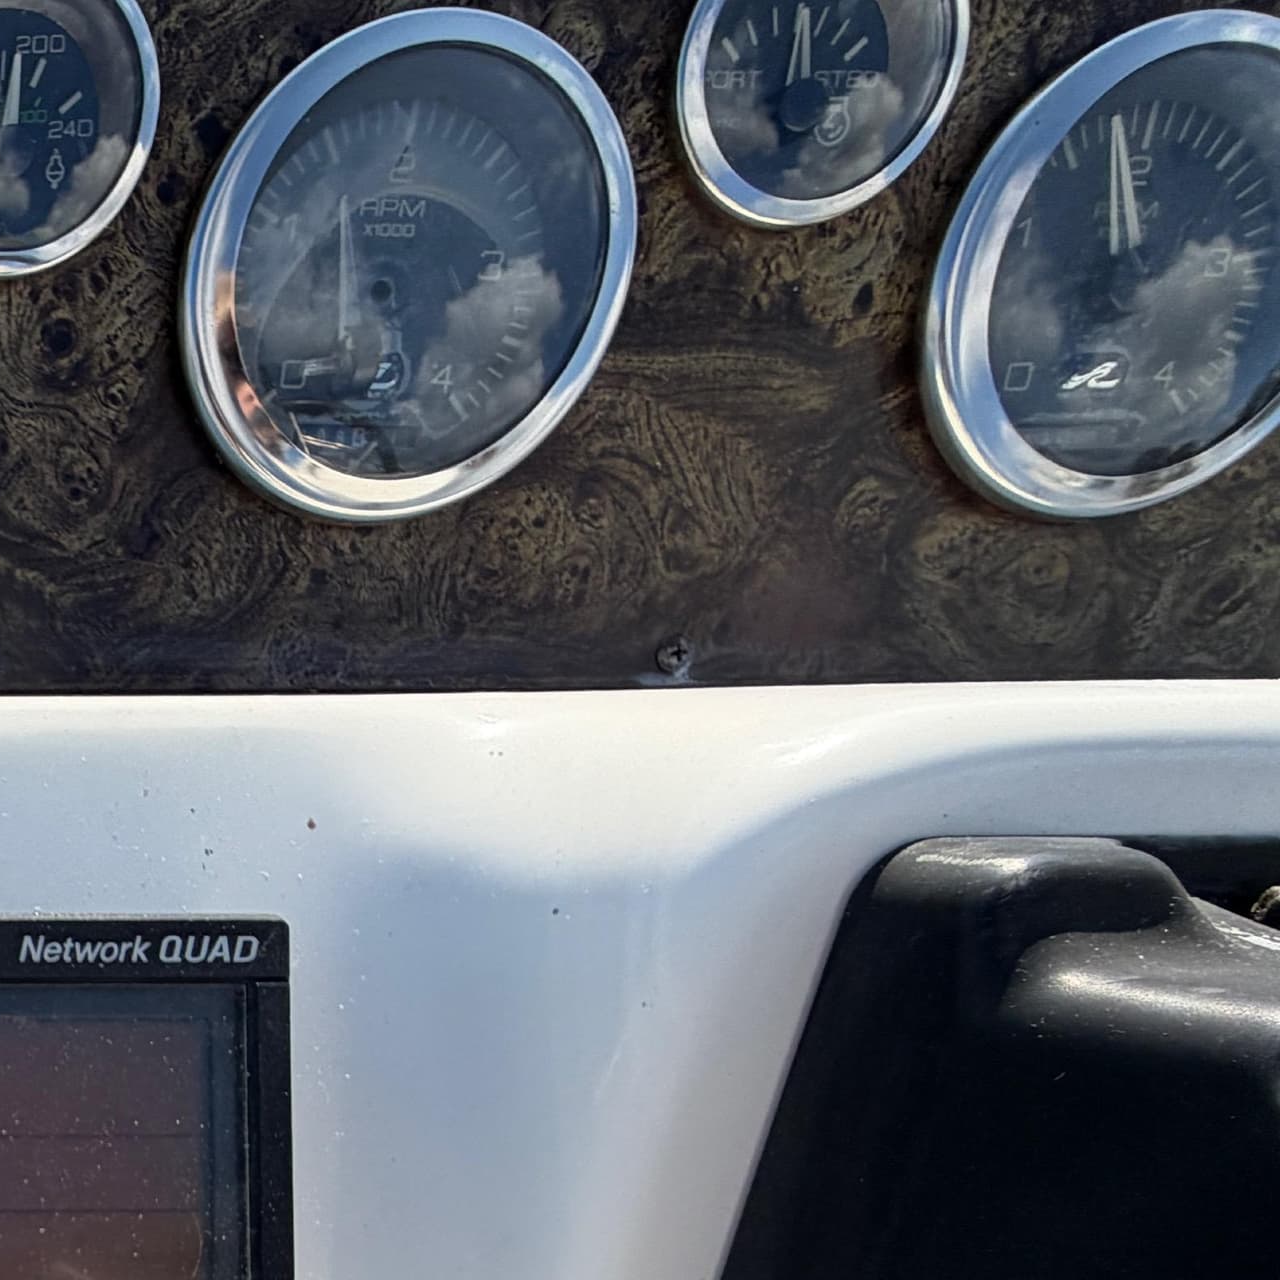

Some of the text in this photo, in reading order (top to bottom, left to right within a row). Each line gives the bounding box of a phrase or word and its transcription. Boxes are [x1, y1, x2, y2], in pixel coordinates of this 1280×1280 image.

[15, 34, 66, 54] 200
[48, 119, 94, 139] 240
[359, 199, 426, 218] RPM
[1203, 247, 1235, 279] 3
[430, 362, 454, 394] 4
[1003, 361, 1035, 392] 0
[1152, 361, 1177, 389] 4
[18, 934, 259, 964] Network QUAD
